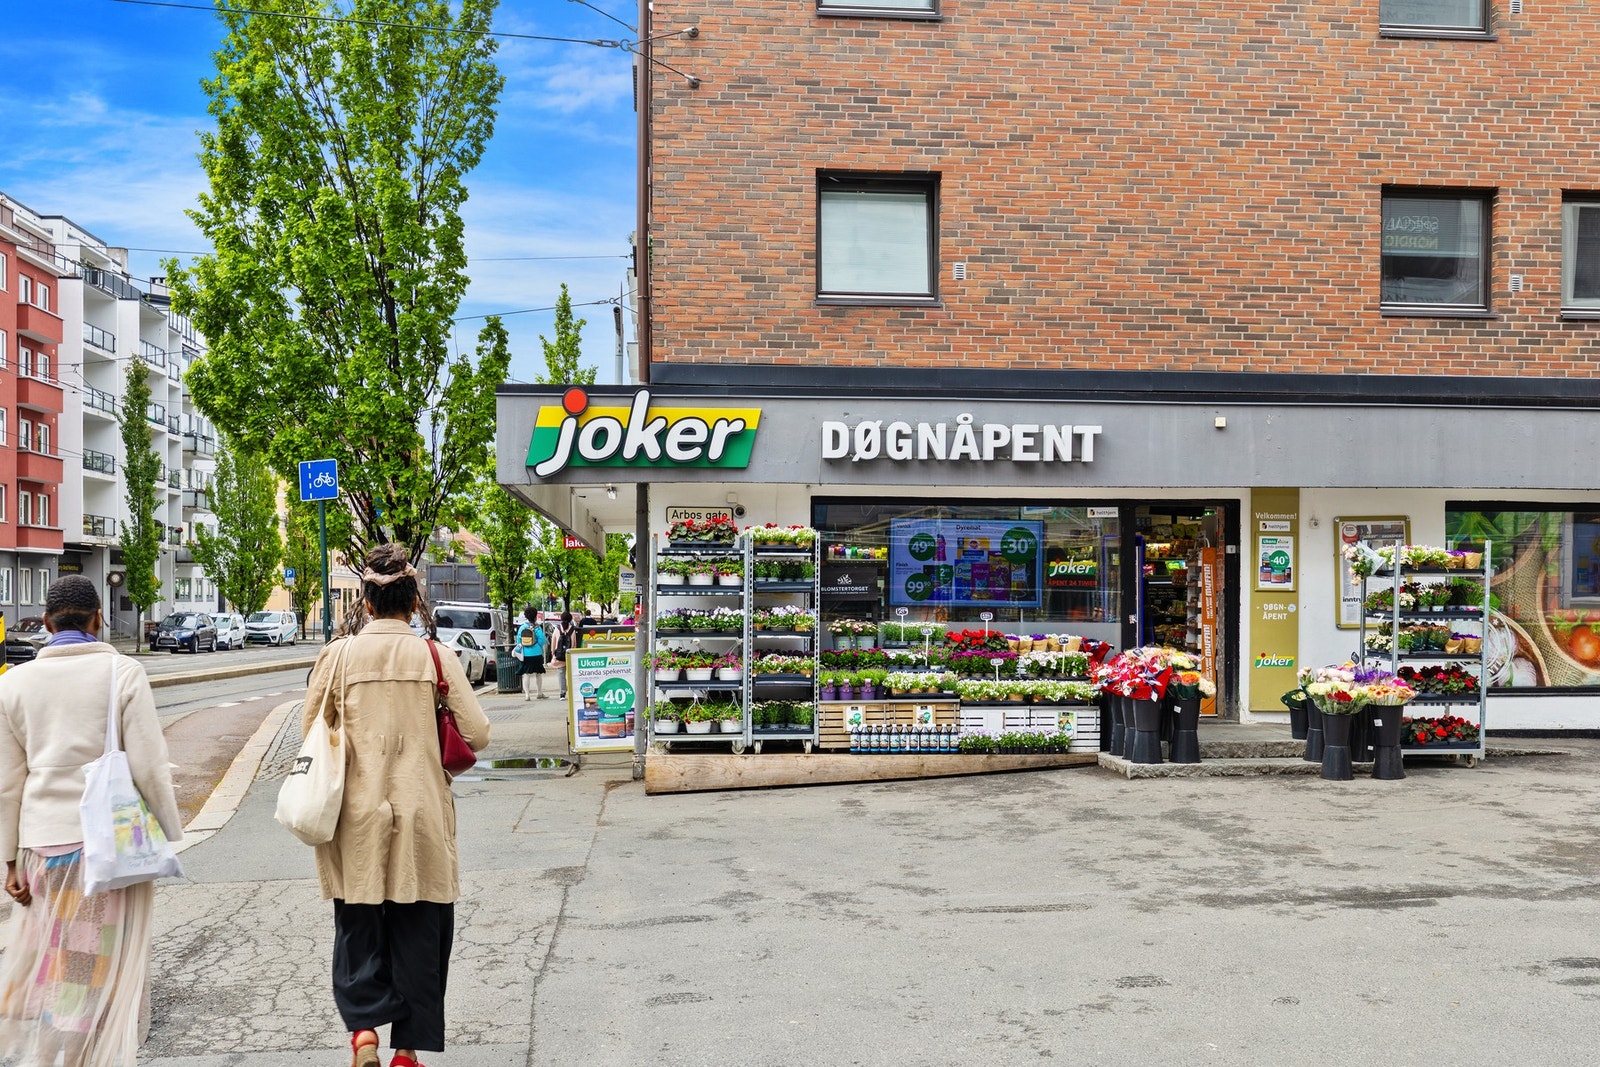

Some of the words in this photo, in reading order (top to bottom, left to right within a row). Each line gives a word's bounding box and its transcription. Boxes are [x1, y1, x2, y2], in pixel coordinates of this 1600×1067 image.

[534, 386, 747, 479] joker
[821, 412, 1103, 463] DØGNÅPENT
[671, 509, 702, 520] Arbos
[1255, 512, 1297, 520] Velkommen!
[1049, 558, 1094, 577] joker
[1262, 612, 1288, 620] ÅPENT
[580, 658, 605, 667] Ukens
[1256, 652, 1292, 669] joker
[578, 669, 602, 677] Stranda
[602, 667, 632, 676] spekemat
[598, 688, 633, 705] -40%
